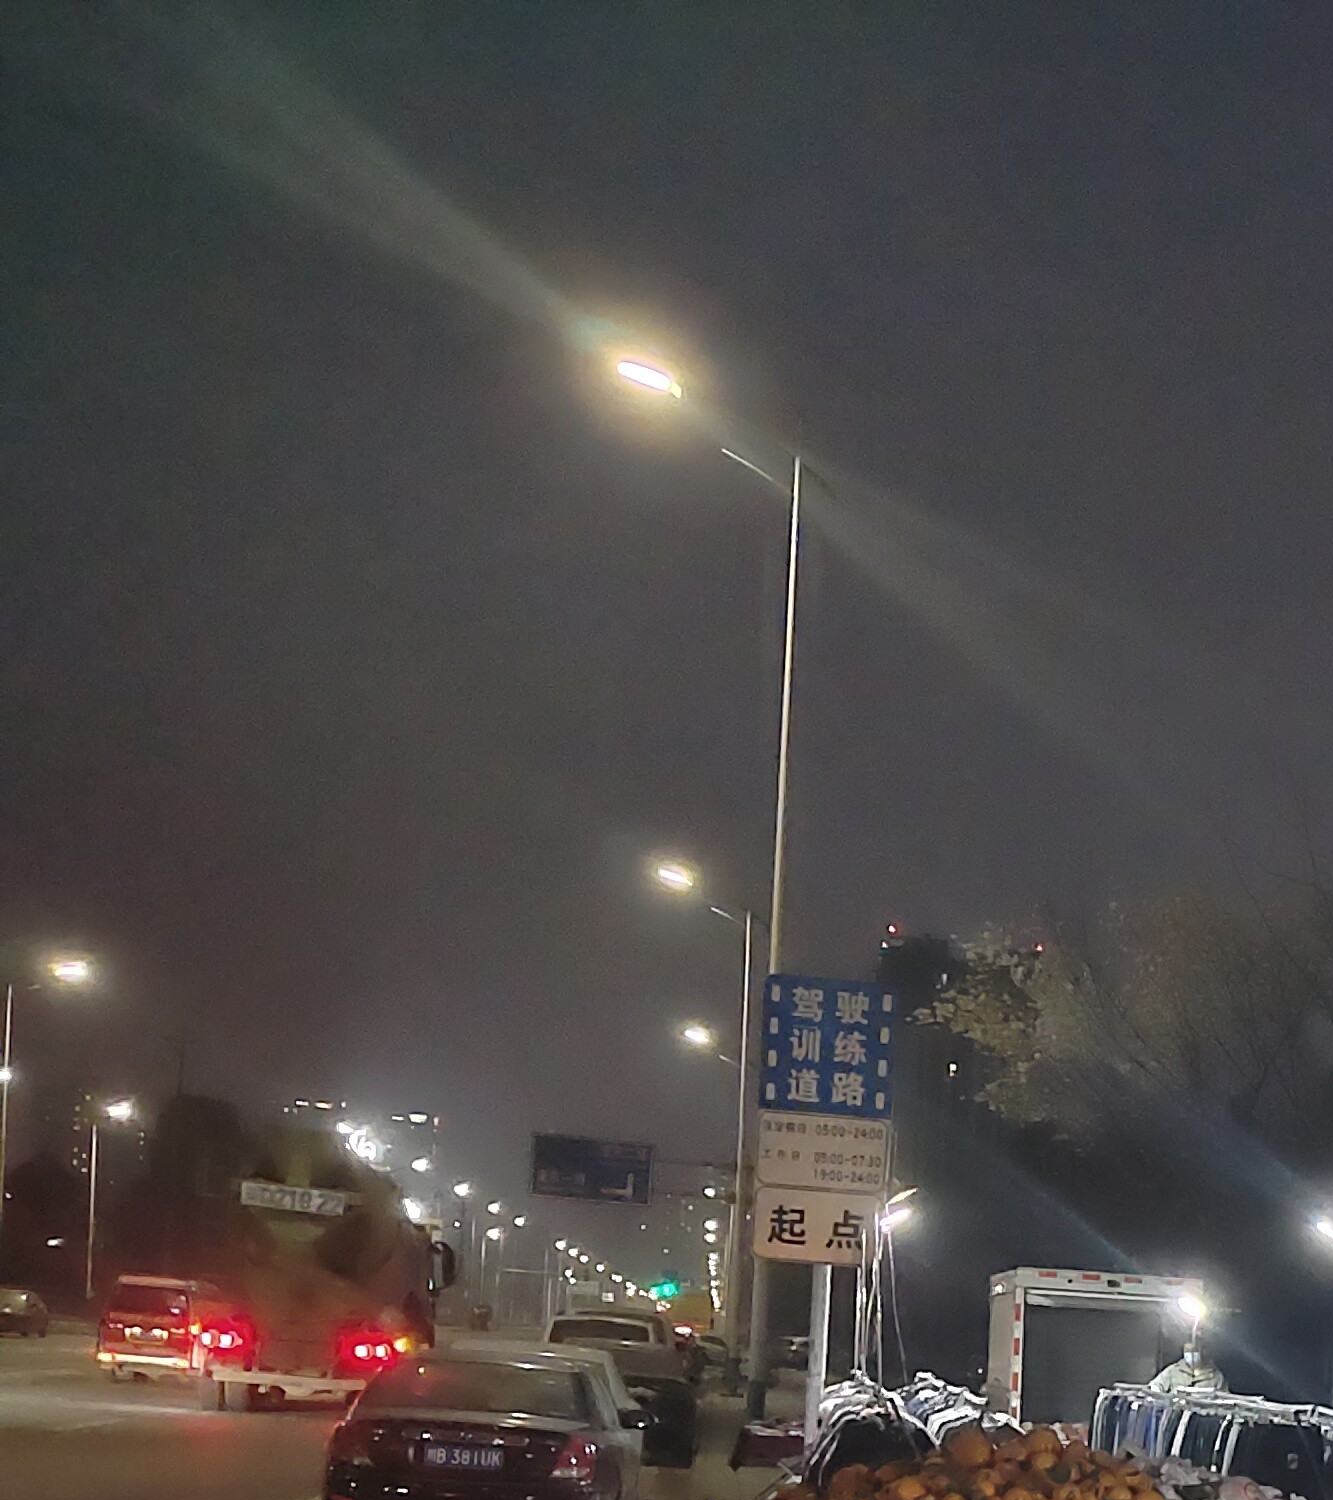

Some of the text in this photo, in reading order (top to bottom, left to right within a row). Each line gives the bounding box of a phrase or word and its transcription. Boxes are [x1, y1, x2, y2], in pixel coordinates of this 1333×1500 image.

[792, 986, 869, 1025] 驾驶
[790, 1027, 867, 1066] 训练
[787, 1068, 865, 1106] 道路
[768, 1205, 864, 1250] 起点
